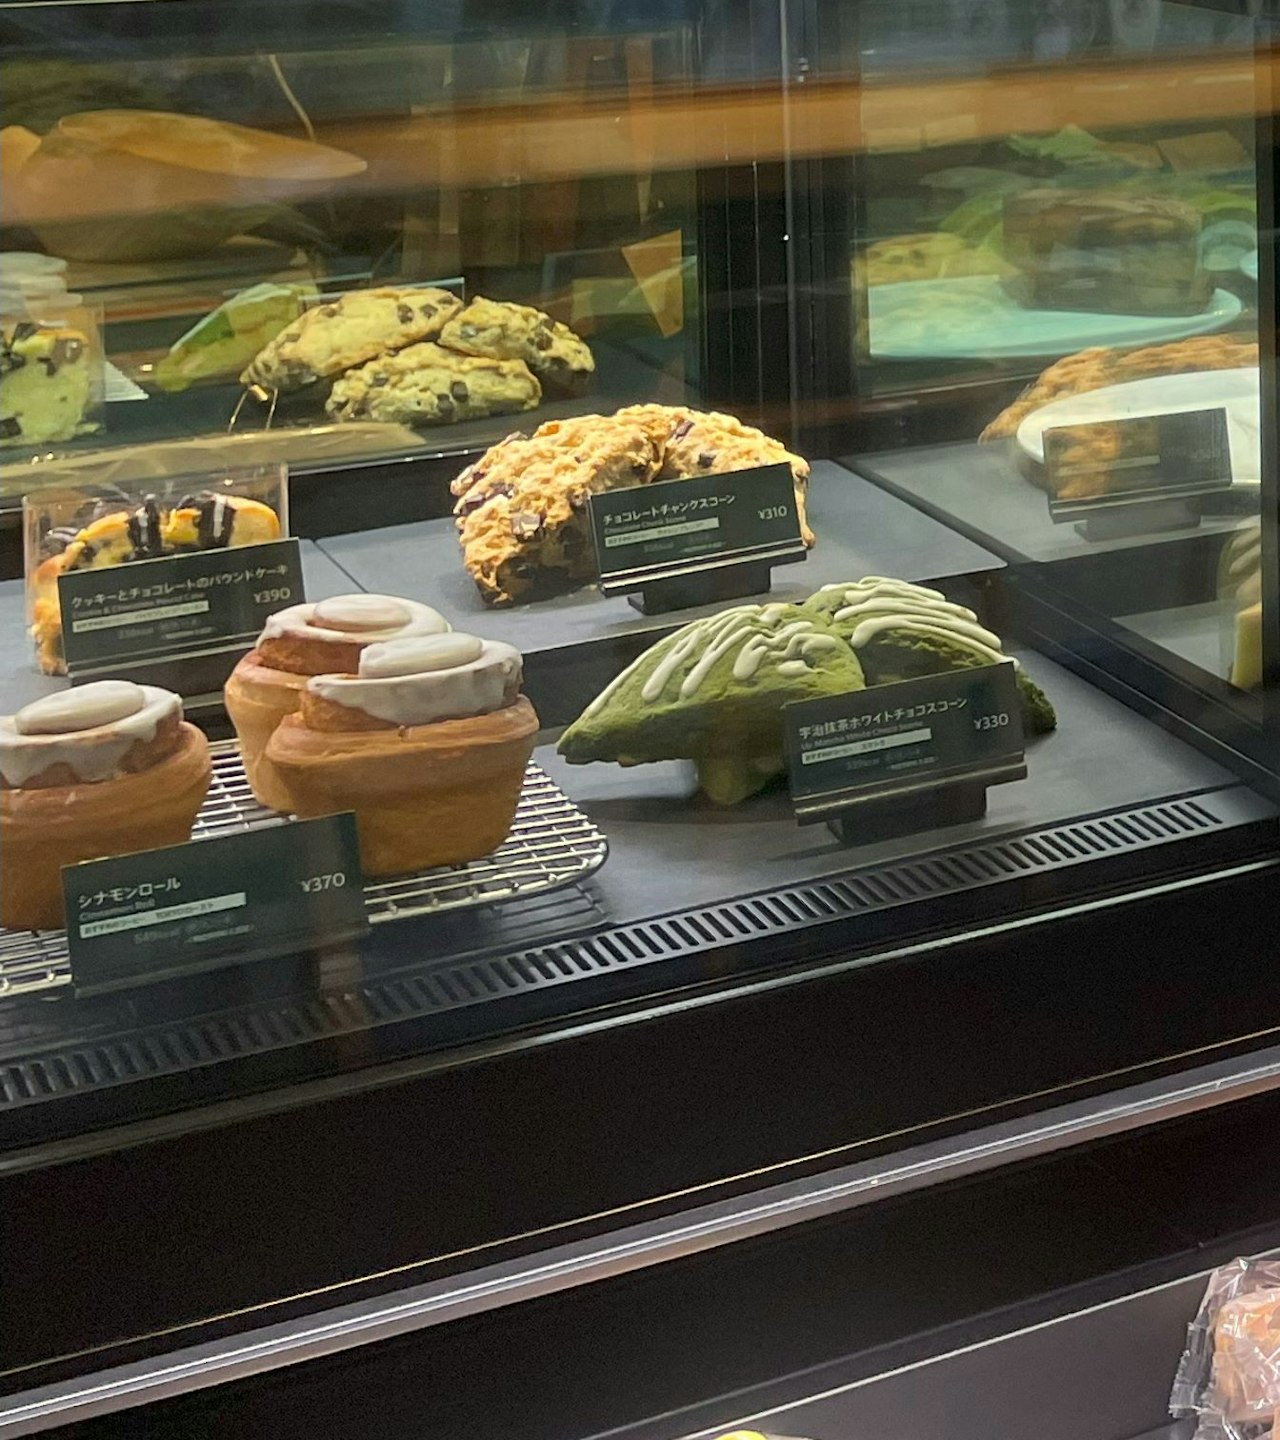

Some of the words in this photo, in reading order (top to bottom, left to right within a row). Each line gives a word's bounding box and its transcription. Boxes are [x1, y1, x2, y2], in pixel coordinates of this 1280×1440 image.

[603, 494, 736, 525] チョコレートチャンクスコーン
[758, 505, 788, 521] ¥310
[71, 564, 289, 609] クッキーとチョコレートのパウンドケーキ
[254, 586, 291, 605] ¥390
[799, 697, 968, 739] 宇治抹茶ホワイトチョコスコーン
[974, 713, 1009, 731] ¥330
[78, 876, 181, 909] シナモンロール
[300, 872, 346, 893] ¥370
